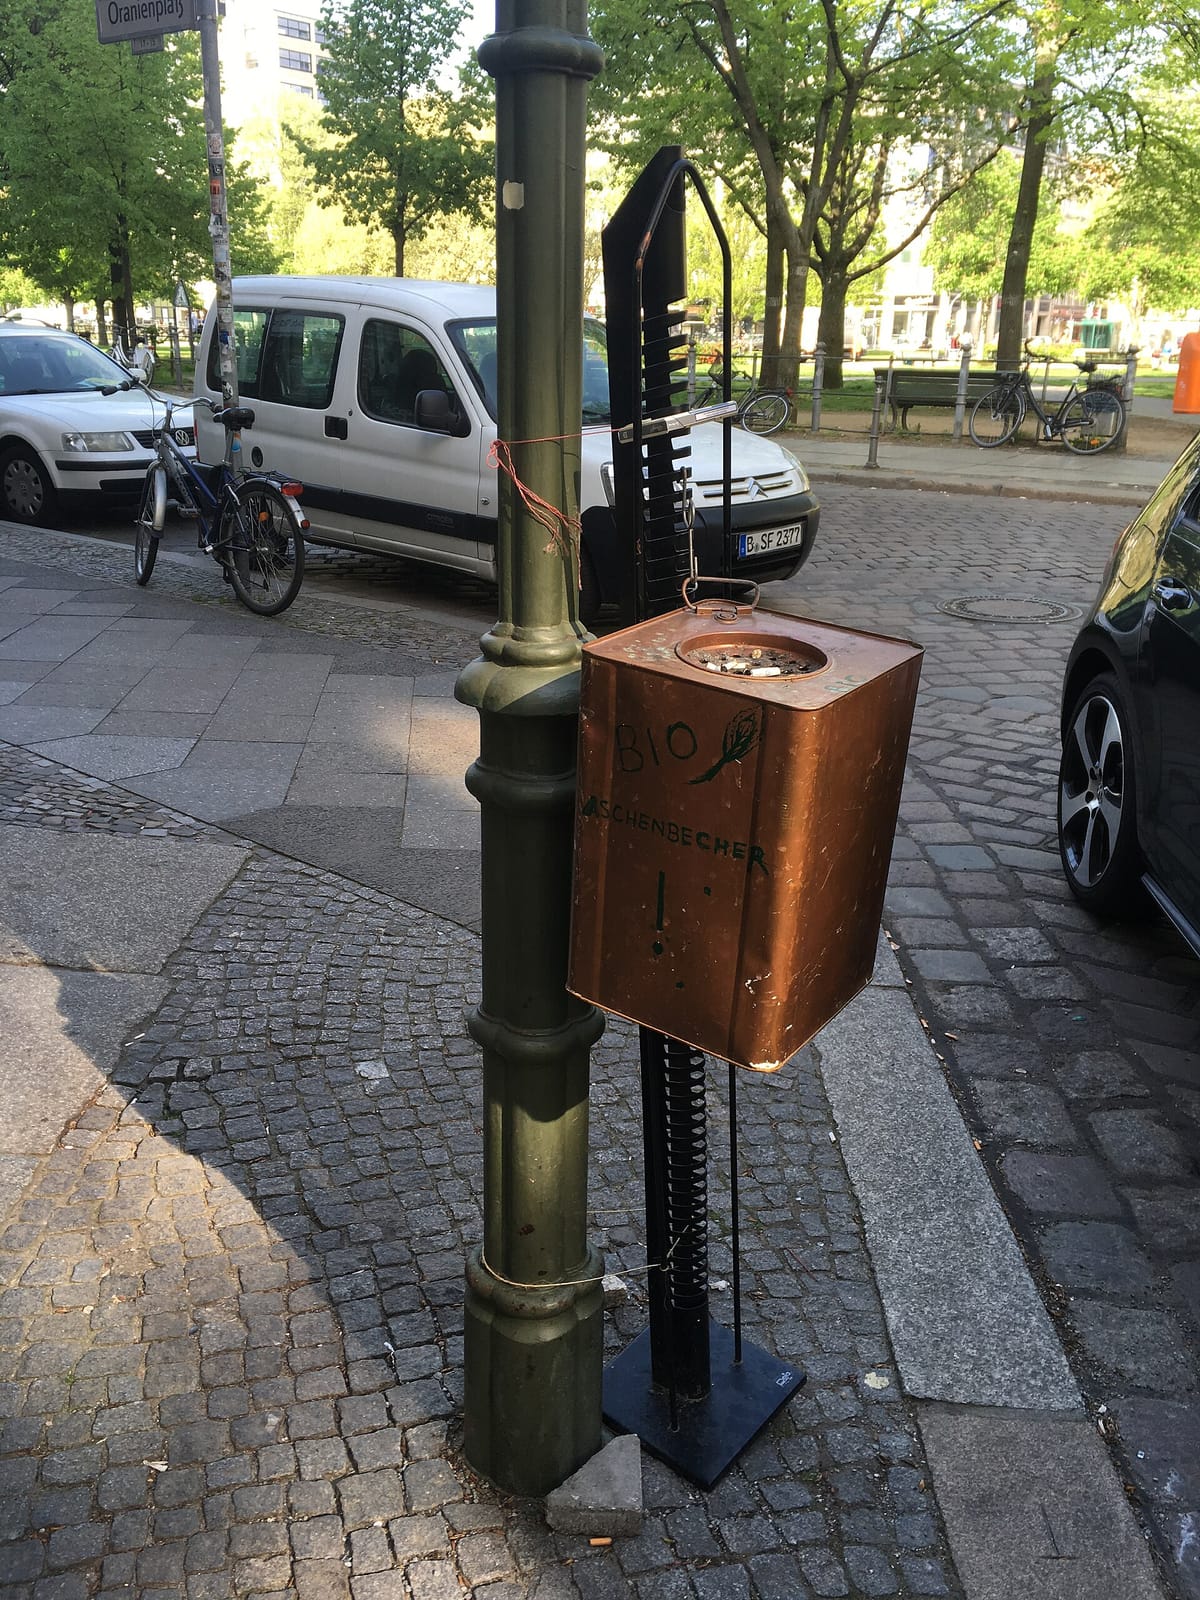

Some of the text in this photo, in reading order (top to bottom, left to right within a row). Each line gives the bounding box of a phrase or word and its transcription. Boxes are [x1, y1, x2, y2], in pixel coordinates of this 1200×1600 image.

[760, 532, 774, 550] SF
[776, 527, 800, 546] 2377
[616, 721, 698, 772] BIO
[582, 795, 769, 875] ASCHENBECHER
